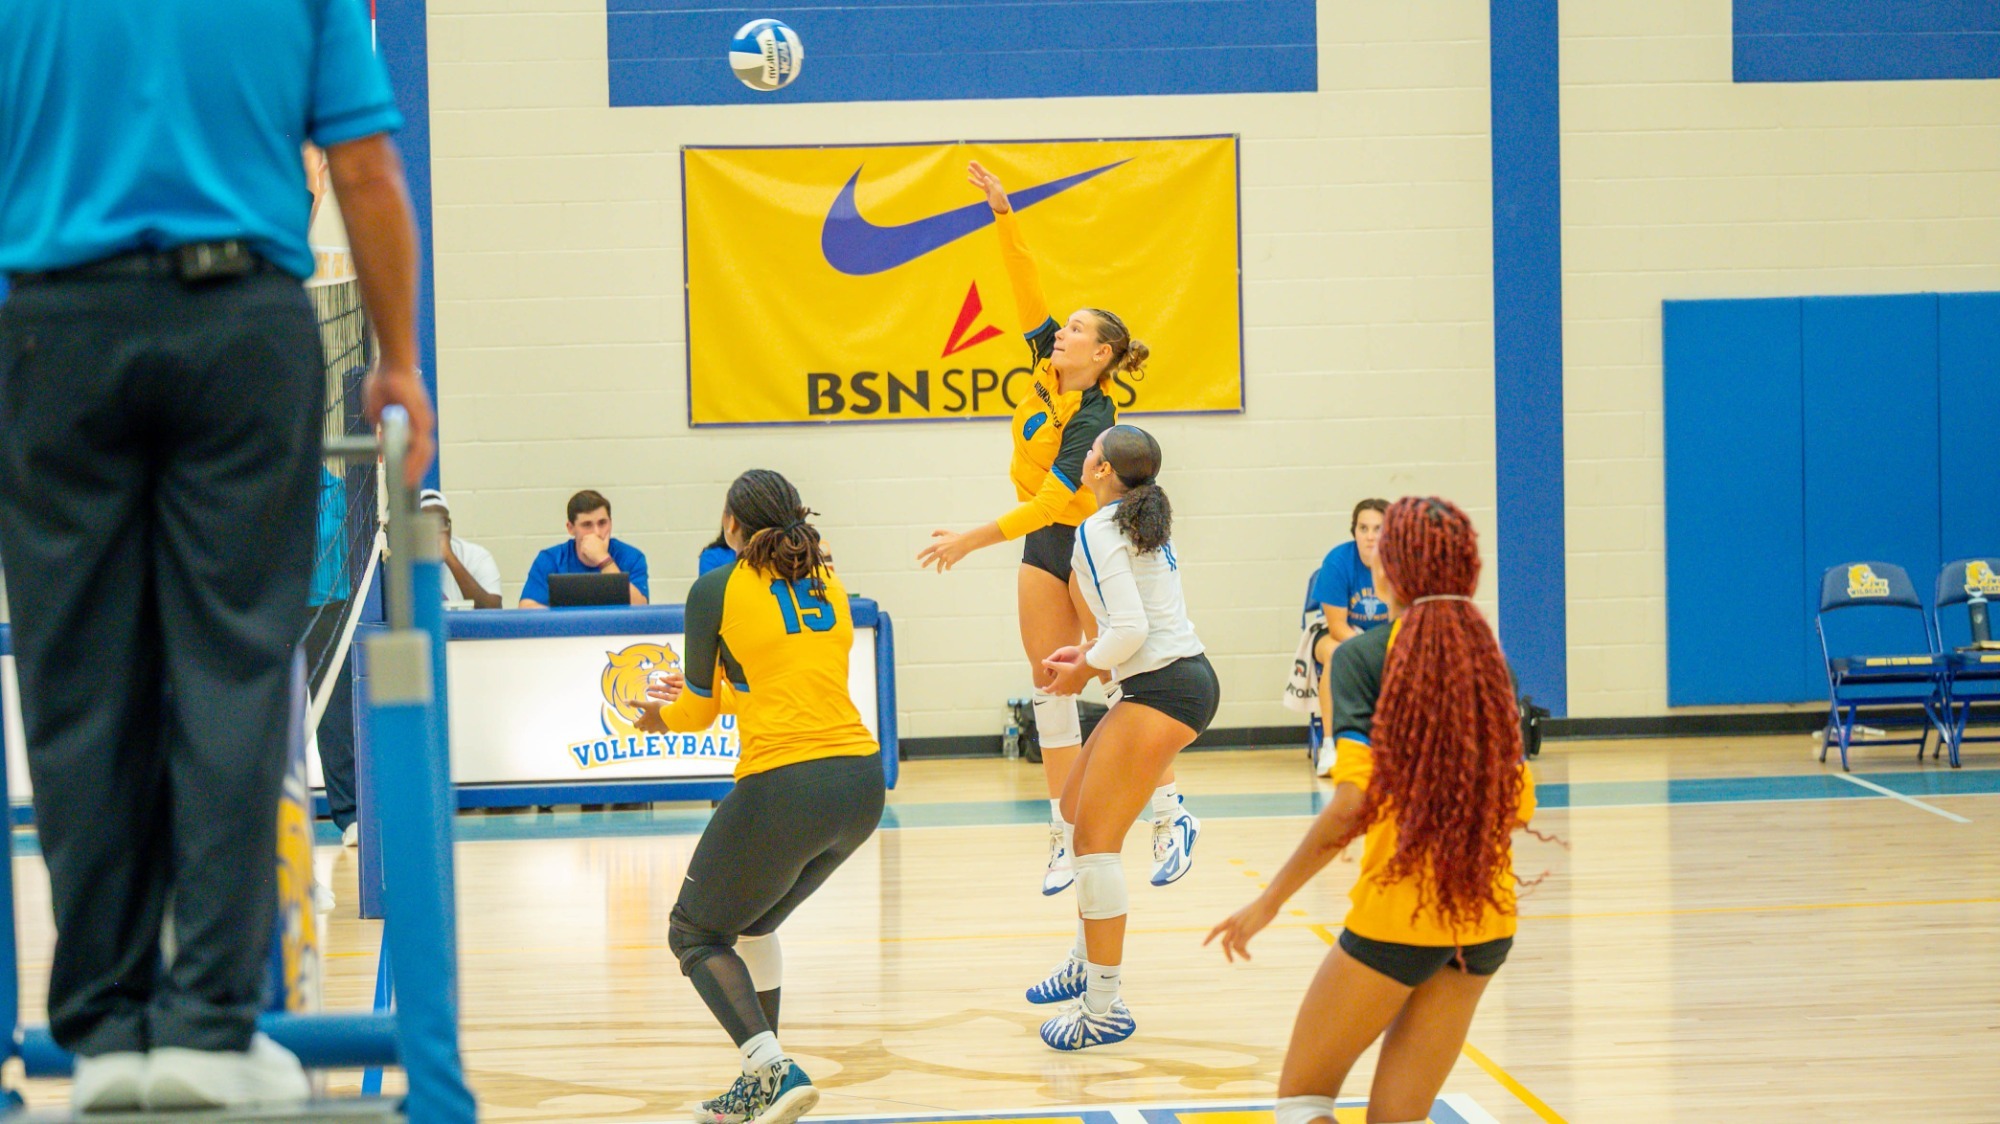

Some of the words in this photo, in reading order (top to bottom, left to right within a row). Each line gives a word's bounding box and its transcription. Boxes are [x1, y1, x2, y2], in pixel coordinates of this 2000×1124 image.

[765, 39, 777, 79] molten
[807, 369, 931, 416] BSN
[942, 366, 1137, 413] SPOS
[769, 577, 837, 635] 15
[573, 735, 741, 766] VOLLEYBAL
